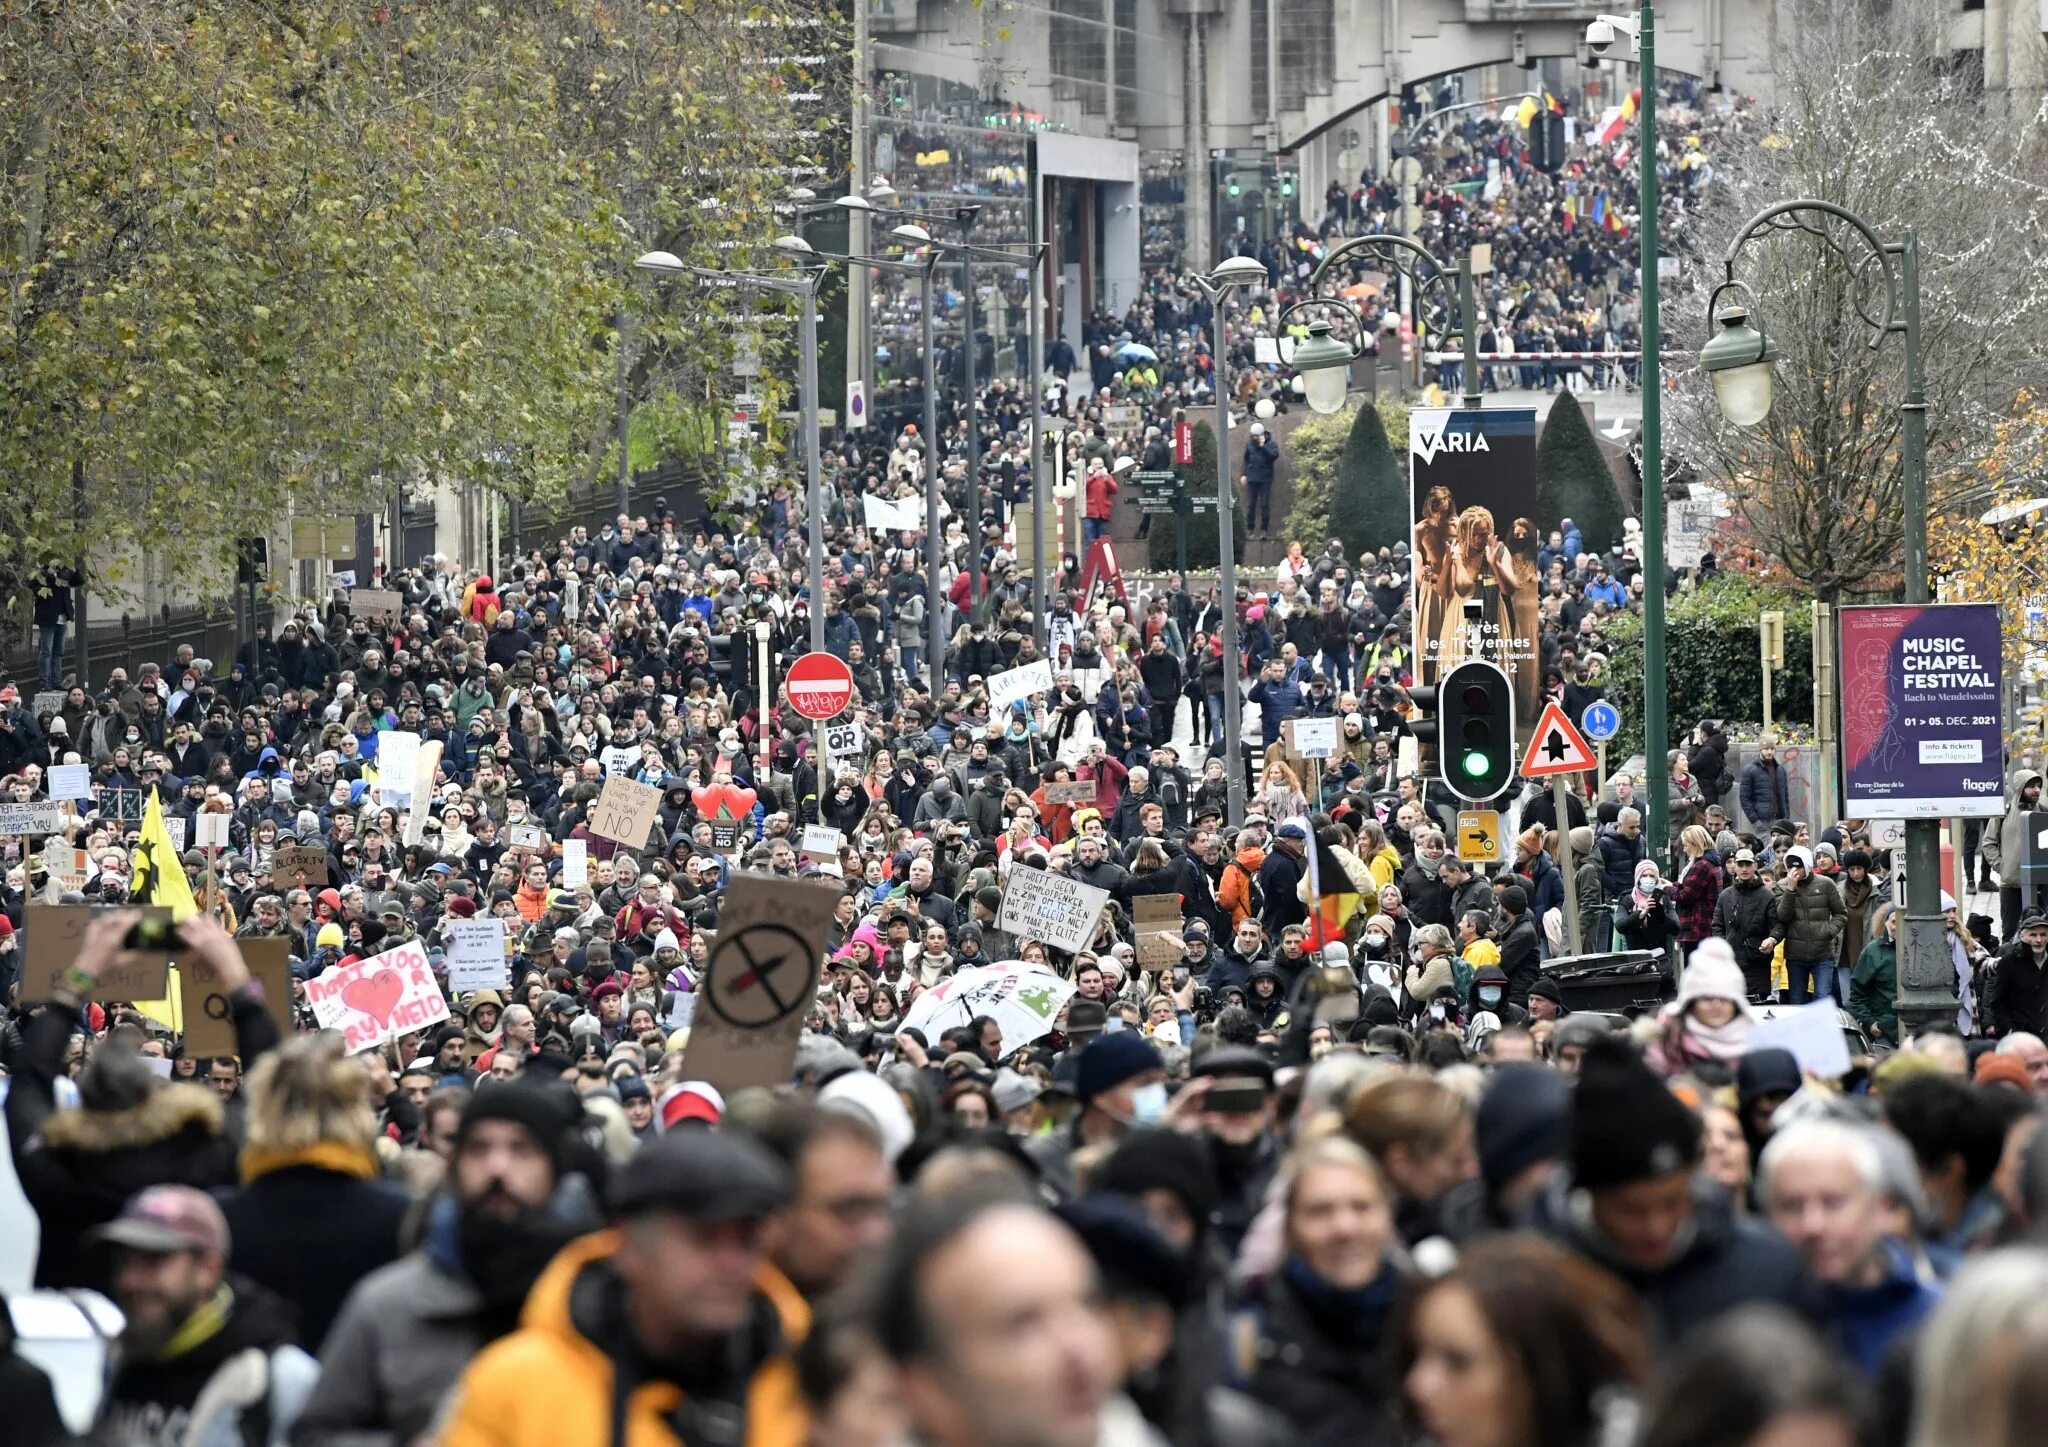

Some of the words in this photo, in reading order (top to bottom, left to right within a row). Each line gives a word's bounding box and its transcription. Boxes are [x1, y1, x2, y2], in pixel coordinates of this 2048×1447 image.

[1420, 432, 1490, 452] VARIA
[1425, 637, 1446, 650] les
[1902, 637, 1966, 654] MUSIC
[1420, 653, 1449, 662] Claudio
[1491, 652, 1502, 660] As
[1503, 652, 1536, 660] Palavras
[1902, 654, 1982, 671] CHAPEL
[1903, 672, 1995, 689] FESTIVAL
[1904, 693, 1926, 702] Bach
[1927, 694, 1937, 702] to
[1938, 692, 1995, 701] Mendelssohn
[1904, 717, 1916, 727] 01
[1928, 717, 1944, 726] 05.
[1946, 716, 1970, 725] DEC.
[1972, 716, 1996, 725] 2021
[828, 730, 857, 750] QR
[1925, 743, 1940, 751] Info
[1950, 742, 1974, 750] tickets
[1925, 752, 1977, 761] www.flagey.be
[613, 778, 630, 791] THIS
[633, 785, 653, 799] ENDS
[1962, 778, 2000, 793] flagey
[25, 802, 57, 812] STERKER
[609, 790, 631, 803] WHEN
[636, 799, 647, 807] WE
[606, 800, 619, 811] ALL
[622, 805, 639, 817] SAY
[603, 812, 633, 838] NO
[715, 838, 732, 847] NO
[1013, 868, 1024, 878] JE
[1026, 871, 1052, 886] HOEFT
[1054, 880, 1077, 896] GEEN
[1011, 887, 1019, 895] TE
[1042, 896, 1054, 906] OM
[1057, 901, 1067, 911] TE
[1068, 906, 1090, 920] ZIEN
[1023, 882, 1084, 908] COMPLOTDENKER
[1006, 897, 1020, 908] DAT
[1023, 901, 1035, 912] DIT
[1037, 905, 1065, 923] BELEID
[1068, 917, 1086, 930] NIET
[1004, 910, 1020, 922] ONS
[1023, 915, 1042, 927] MAAR
[1044, 921, 1054, 932] DE
[1055, 925, 1079, 943] ELITE
[1026, 927, 1053, 942] DIENT
